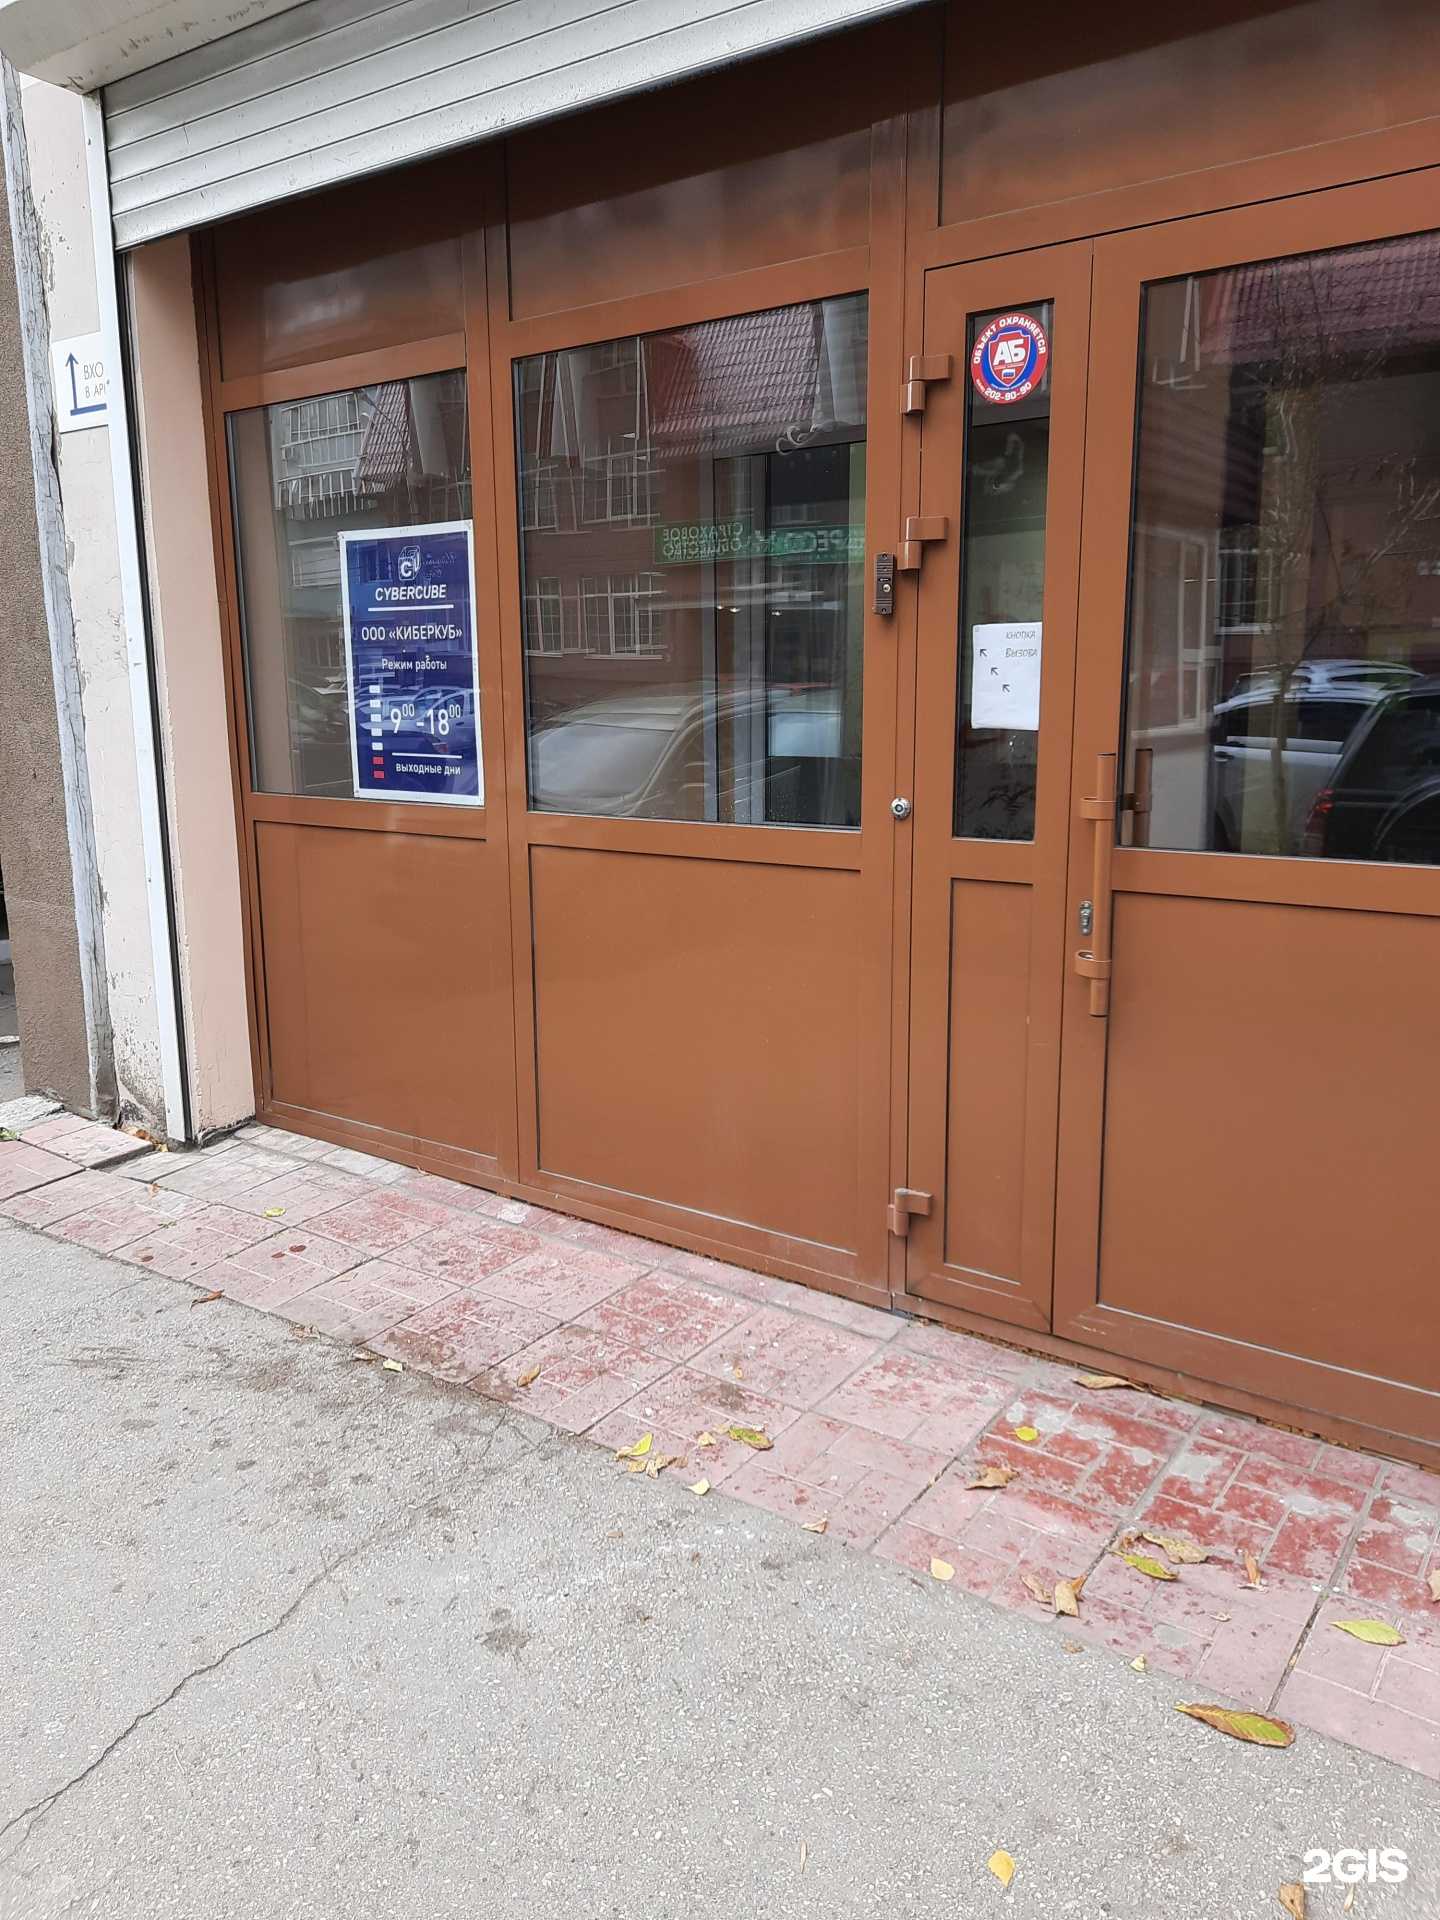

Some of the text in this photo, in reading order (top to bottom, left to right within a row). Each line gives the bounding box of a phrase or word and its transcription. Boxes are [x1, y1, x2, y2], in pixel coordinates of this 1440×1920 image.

[974, 316, 1046, 364] ОБЪЕКТ ОХРАНЯЕТСЯ
[993, 338, 1026, 366] АБ
[375, 584, 447, 601] CYBERCUBE
[361, 624, 463, 641] ООО «КИБЕРКУБ»
[381, 657, 447, 672] Режим работы
[395, 763, 461, 776] выходные дни
